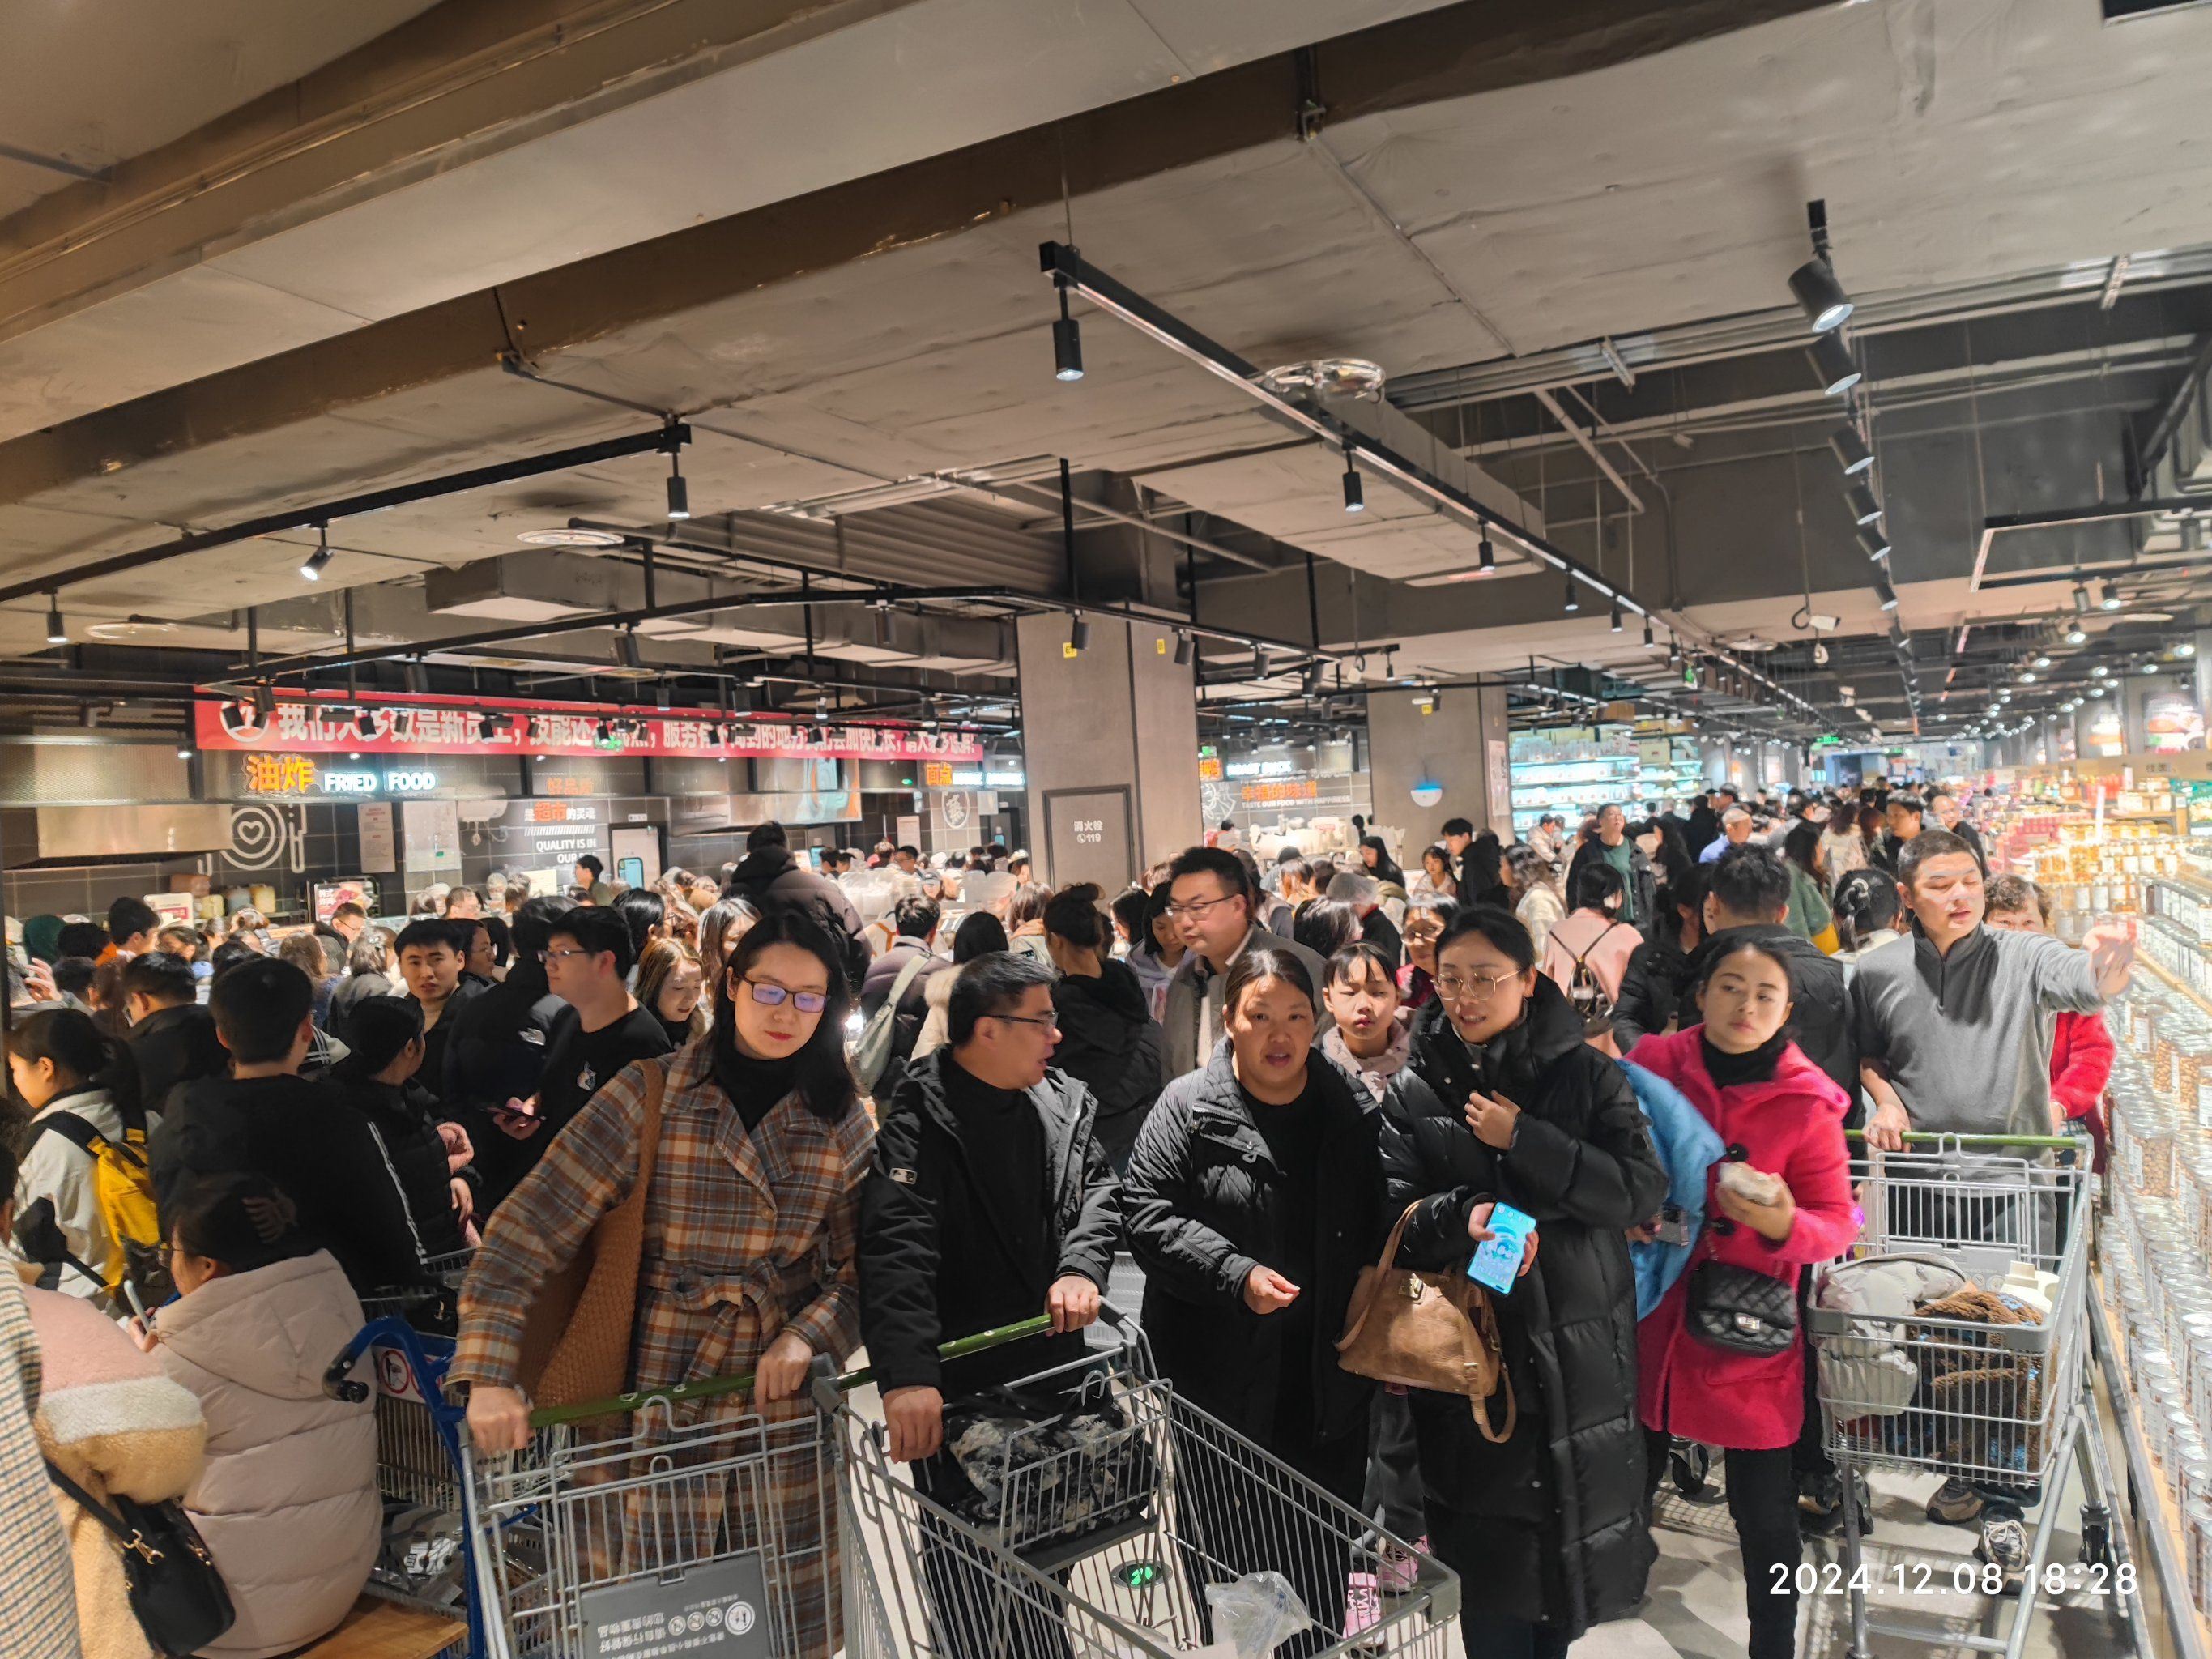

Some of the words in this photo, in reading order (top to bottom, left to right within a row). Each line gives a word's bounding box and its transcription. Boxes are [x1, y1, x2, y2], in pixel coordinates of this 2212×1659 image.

[246, 754, 316, 792] 油炸
[926, 762, 953, 786] 面点
[1199, 758, 1222, 780] 鸭
[324, 773, 377, 791] FRIED
[388, 772, 436, 791] FOOD
[1242, 780, 1317, 800] 幸福的味道
[524, 801, 596, 822] 是超市的灵魂
[1073, 820, 1103, 832] 消火栓
[536, 839, 575, 852] QUALITY
[577, 838, 586, 849] IS
[586, 838, 597, 848] IN
[1086, 834, 1102, 842] 119
[557, 853, 577, 864] OUR
